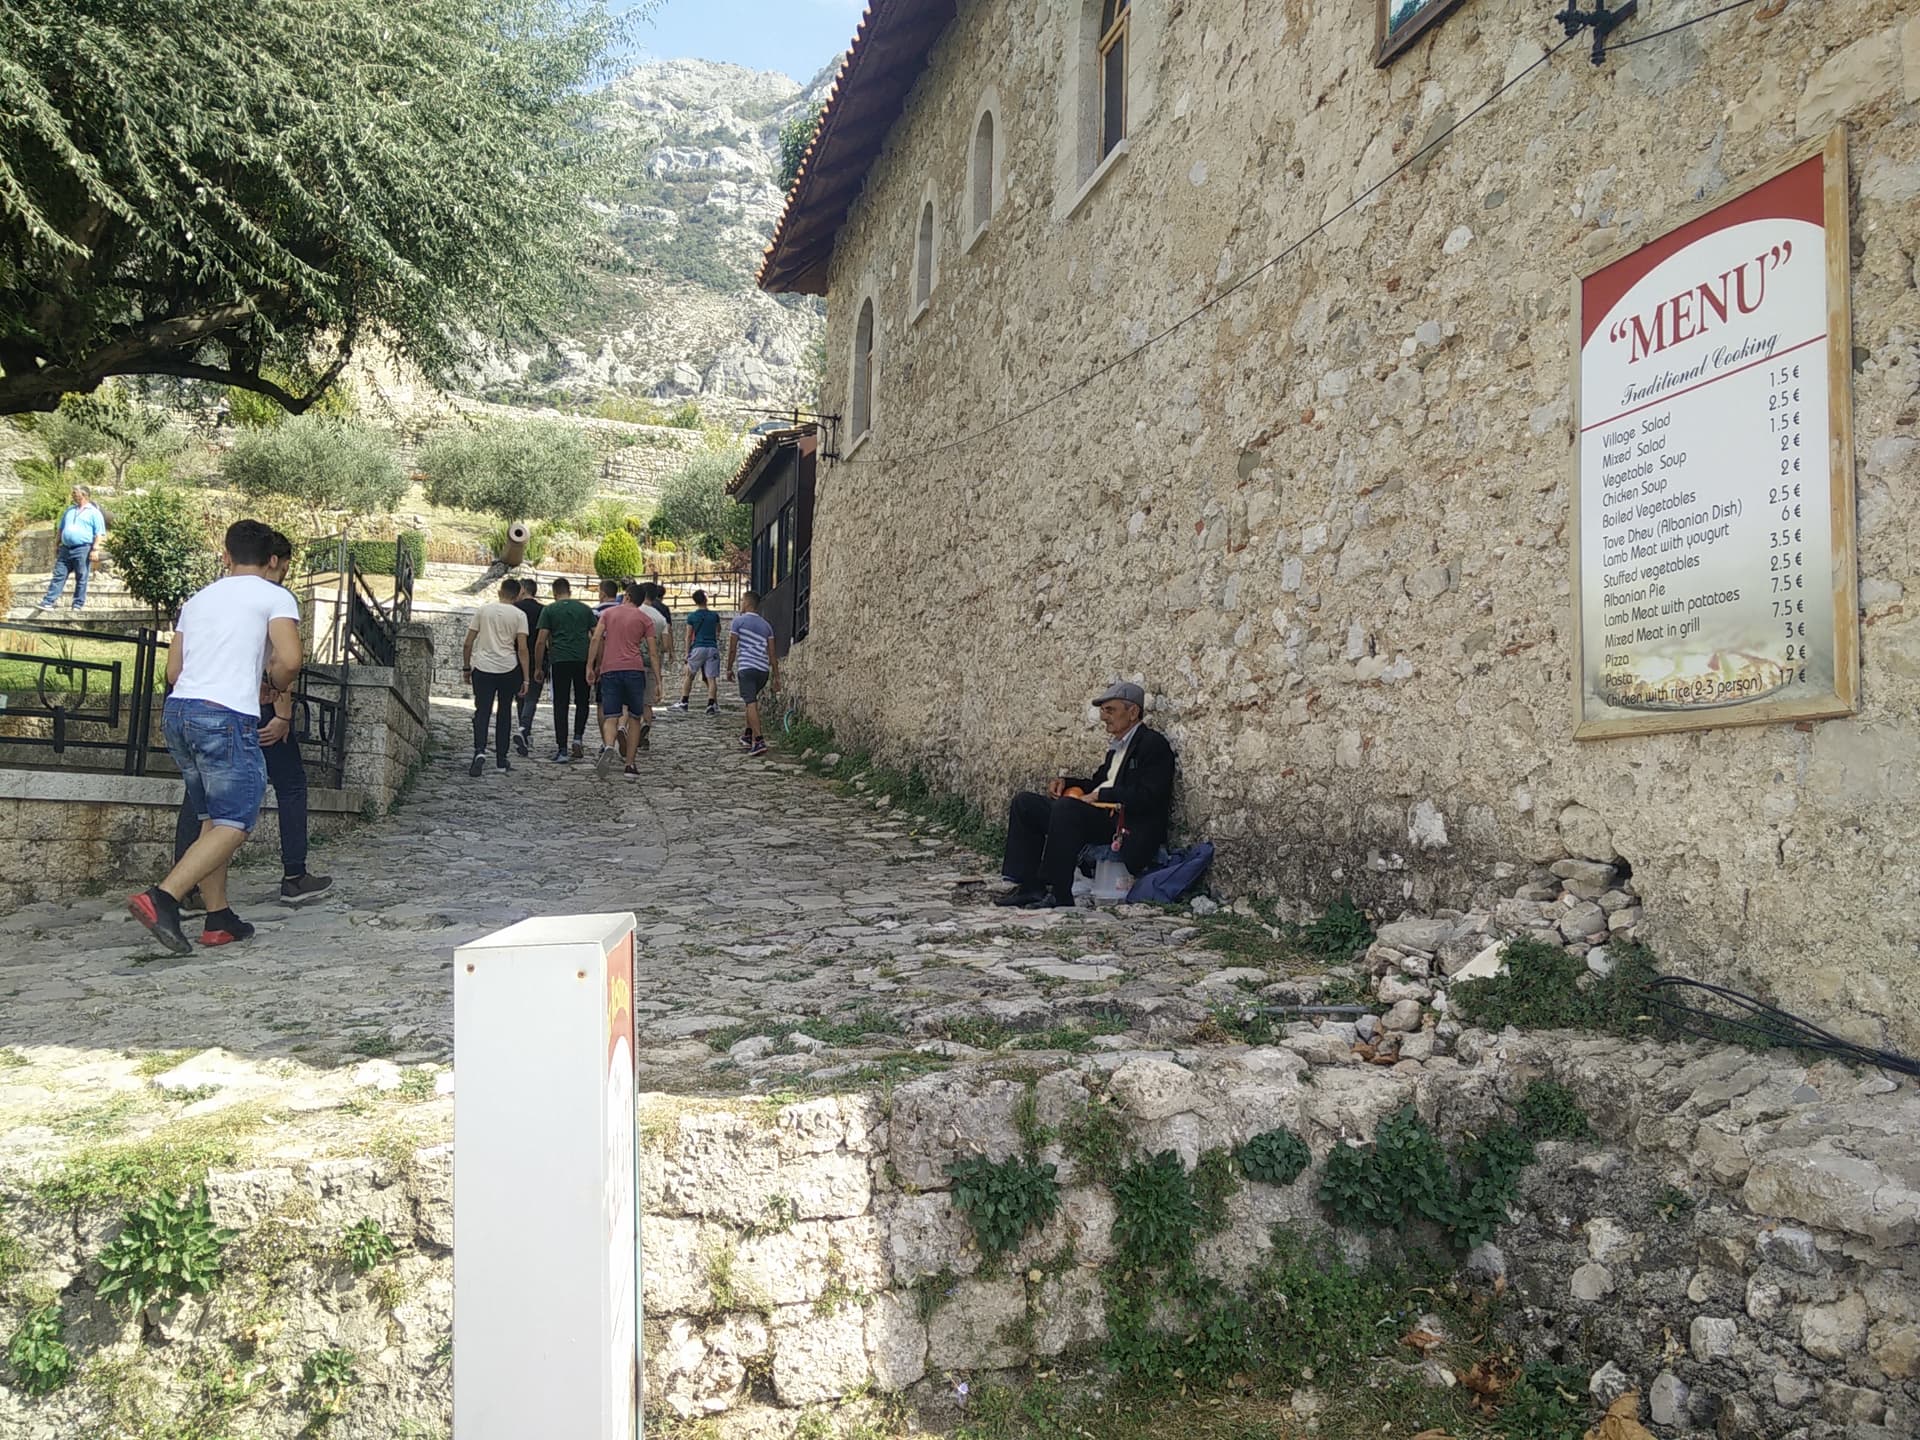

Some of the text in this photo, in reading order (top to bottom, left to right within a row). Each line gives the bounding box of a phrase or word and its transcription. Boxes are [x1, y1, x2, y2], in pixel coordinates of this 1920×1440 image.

[1621, 333, 1781, 406] Traditional Cooking
[1769, 364, 1800, 387] 1.5 €
[1768, 387, 1800, 411] 2.5 €
[1602, 412, 1671, 449] Village Salad
[1769, 411, 1800, 433] 1.5 €
[1602, 434, 1666, 469] Mixed Salad
[1781, 433, 1800, 451] 2 €
[1602, 451, 1687, 489] Vegetable Soup
[1781, 457, 1801, 476] 2 €
[1602, 478, 1668, 507] Chicken Soup
[1769, 482, 1801, 504] 2.5 €
[1602, 491, 1697, 529] Boiled Vegetables
[1628, 528, 1654, 544] Dheu
[1656, 511, 1709, 538] (Albanian
[1712, 498, 1743, 520] Dish)
[1781, 503, 1801, 521] 6 €
[1602, 523, 1730, 568] Lamb Meat with yougurt
[1769, 527, 1802, 549] 3.5 €
[1603, 553, 1701, 589] Stuffed vegetables
[1770, 551, 1802, 572] 2.5 €
[1771, 573, 1803, 594] 7.5 €
[1603, 583, 1666, 609] Albanian Pie
[1604, 611, 1630, 628] Lamb
[1631, 605, 1659, 622] Meat
[1661, 597, 1685, 616] with
[1772, 598, 1804, 618] 7.5 €
[1604, 615, 1700, 649] Mixed Meat in grill
[1785, 621, 1805, 639] 3 €
[1605, 654, 1629, 669] Pizza
[1786, 643, 1806, 661] 2 €
[1605, 673, 1633, 689] Pasta
[1780, 668, 1806, 686] 17 €
[1606, 692, 1643, 708] Chicken
[1645, 686, 1668, 703] with
[1717, 672, 1763, 698] person)
